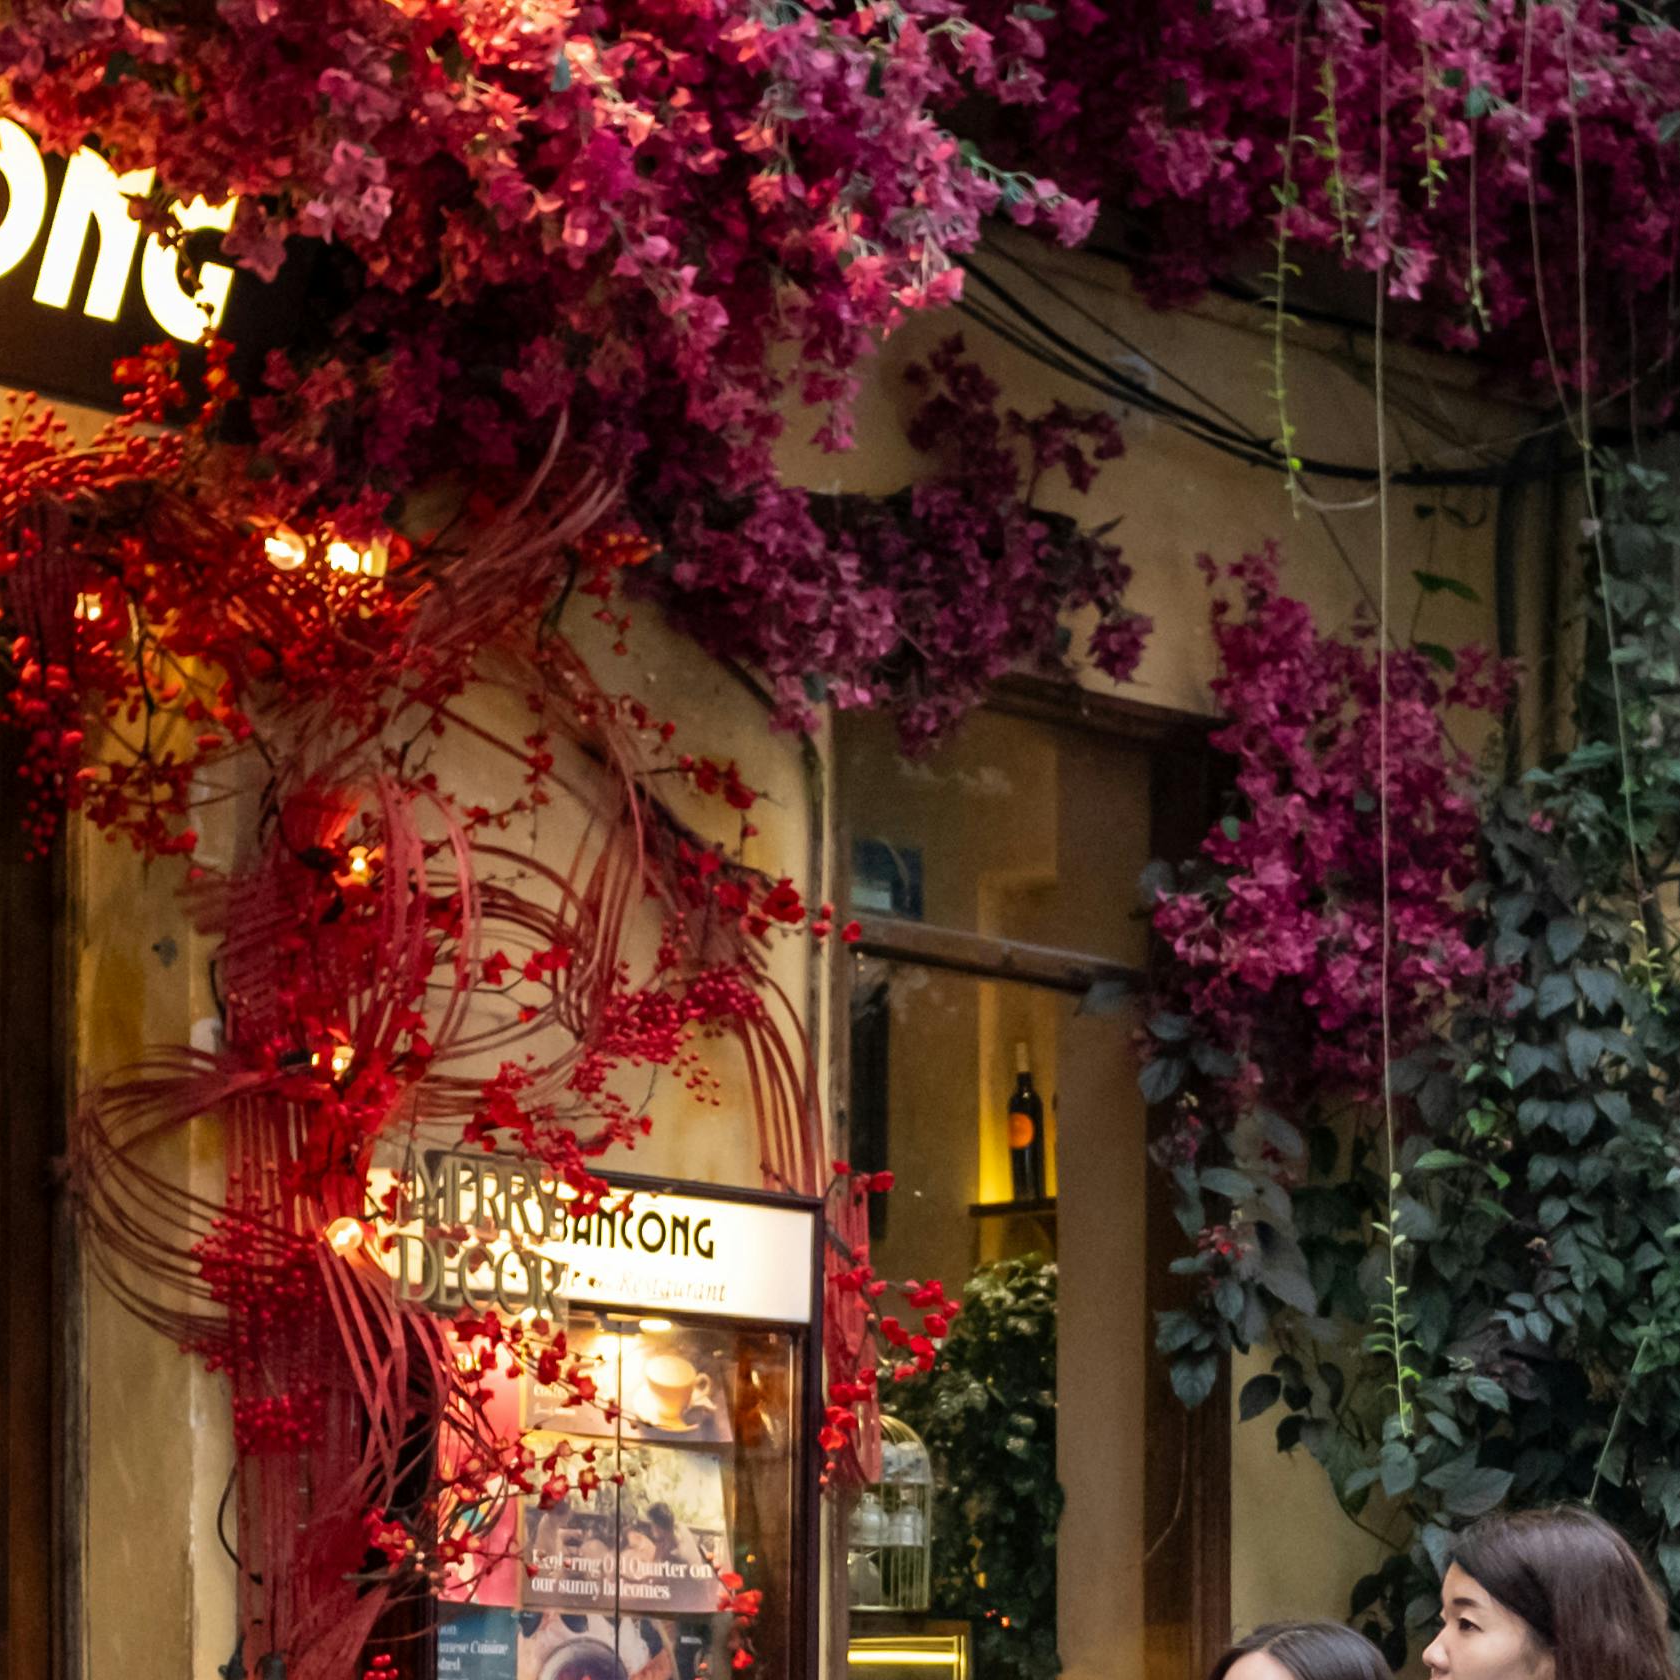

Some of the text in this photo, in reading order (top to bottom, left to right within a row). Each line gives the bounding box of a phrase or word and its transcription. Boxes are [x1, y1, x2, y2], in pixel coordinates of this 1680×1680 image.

[689, 1563, 713, 1579] on
[531, 1576, 555, 1594] our
[558, 1578, 600, 1601] sunny
